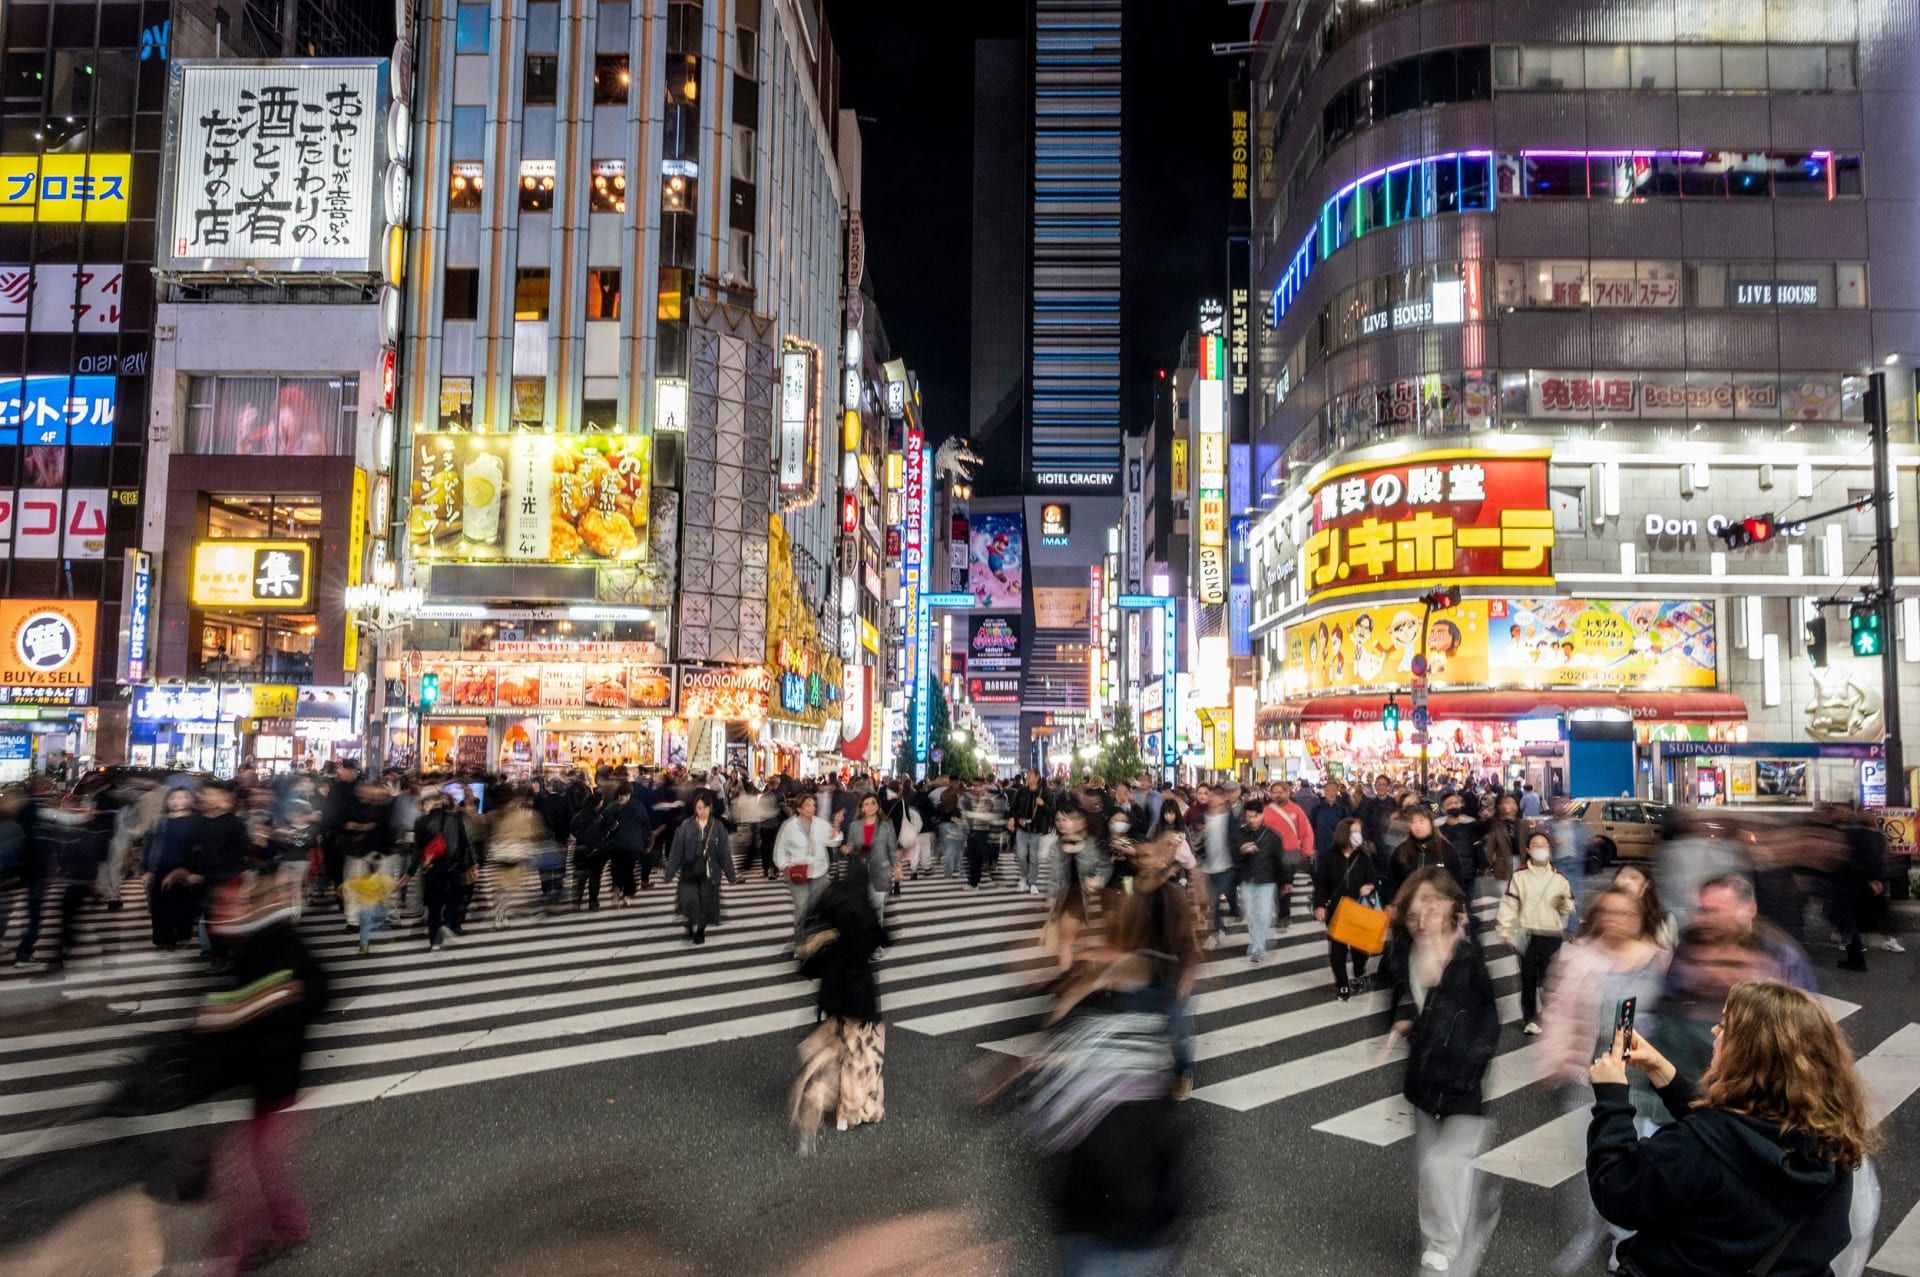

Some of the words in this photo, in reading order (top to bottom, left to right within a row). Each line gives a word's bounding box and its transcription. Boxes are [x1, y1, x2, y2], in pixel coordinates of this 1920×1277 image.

[190, 109, 241, 246] だけの店
[292, 103, 325, 244] こだわりの
[8, 173, 124, 200] プロミス
[1738, 285, 1771, 304] LIVE
[1778, 285, 1818, 304] HOUSE
[1364, 311, 1388, 334] LIVE
[1393, 302, 1432, 327] HOUSE
[1539, 378, 1635, 411] 免税店
[1645, 385, 1712, 405] Bebas
[40, 432, 56, 443] 4F
[1038, 473, 1069, 485] HOTEL
[1070, 473, 1114, 485] GRACERY
[1645, 513, 1698, 536] Don
[1042, 537, 1069, 546] IMAX
[257, 551, 300, 596] 集
[1201, 550, 1223, 600] CASINO
[4, 671, 37, 683] BUY
[48, 671, 85, 684] SELL
[683, 673, 772, 691] OKONOMIYAKI
[1352, 708, 1378, 720] Don
[1667, 744, 1730, 757] SUBNADE
